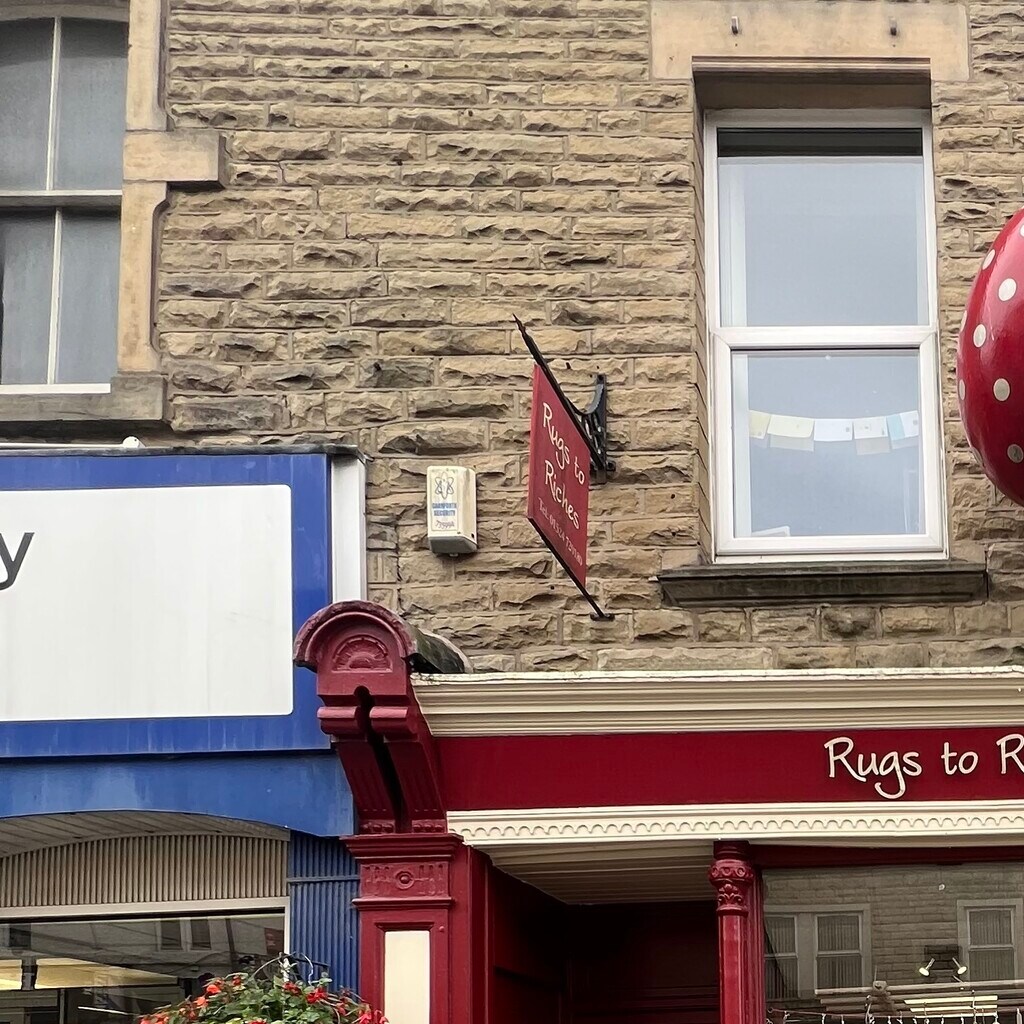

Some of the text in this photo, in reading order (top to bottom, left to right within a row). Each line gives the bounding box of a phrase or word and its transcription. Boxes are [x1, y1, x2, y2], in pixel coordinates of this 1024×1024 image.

[543, 402, 585, 485] Rugs to
[545, 460, 579, 529] Riches
[824, 736, 922, 799] Rugs
[941, 742, 979, 775] to
